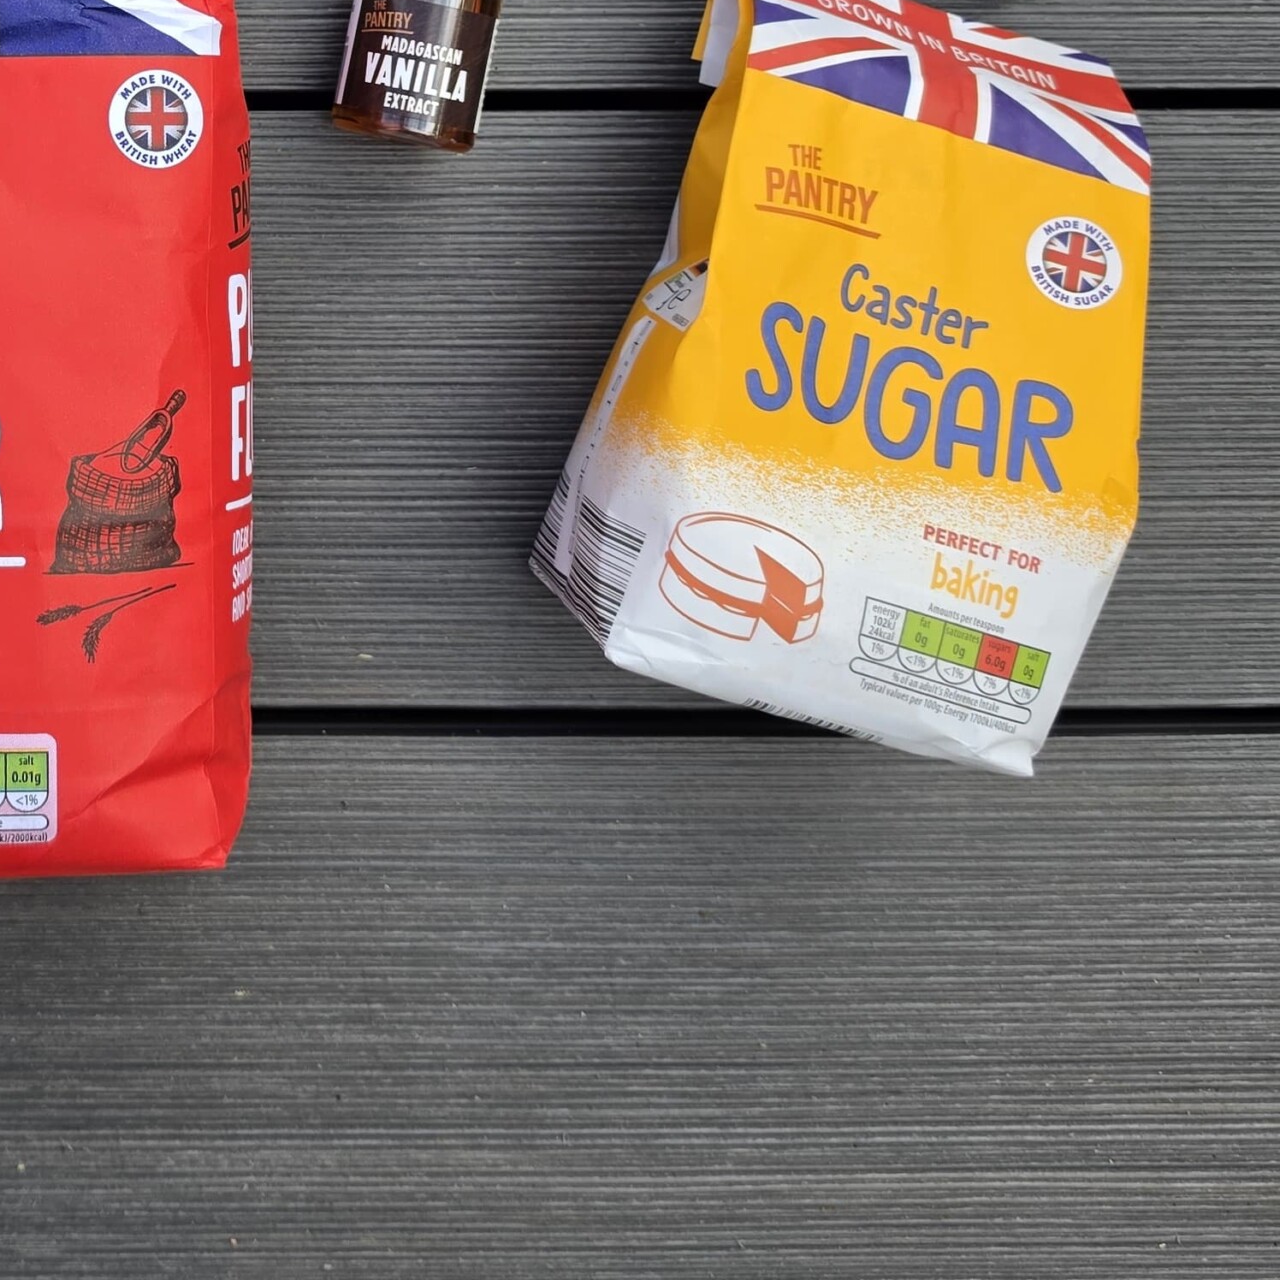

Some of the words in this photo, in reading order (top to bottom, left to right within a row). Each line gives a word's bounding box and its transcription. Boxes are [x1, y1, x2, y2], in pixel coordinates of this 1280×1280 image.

[374, 0, 387, 10] THE
[365, 12, 413, 29] PANTRY
[381, 35, 463, 66] MADAGASCAN
[918, 31, 946, 54] IN
[950, 45, 1058, 91] BRITAIN
[365, 51, 468, 103] VANILLA
[120, 75, 155, 100] MADE
[161, 75, 192, 100] WITH
[383, 92, 439, 117] EXTRACT
[115, 131, 158, 166] BRITISH
[162, 130, 197, 165] WHEAT
[788, 143, 823, 171] THE
[765, 166, 879, 225] PANTRY
[1043, 220, 1079, 236] MADE
[1085, 224, 1114, 252] WITH
[1031, 265, 1069, 303] BRITISH
[1075, 284, 1114, 305] SUGAR
[841, 263, 989, 349] Caster
[745, 301, 1073, 493] SUGAR
[923, 524, 1003, 562] PERFECT
[1007, 549, 1041, 574] FOR
[931, 551, 1019, 619] baking
[872, 604, 901, 620] energy
[928, 602, 960, 621] Amounts
[960, 614, 973, 625] per
[973, 617, 1005, 634] teaspoon
[873, 616, 896, 630] 102kJ
[920, 616, 931, 629] fat
[868, 626, 896, 641] 24kcal
[915, 633, 928, 648] 0g
[946, 627, 980, 644] saturates
[871, 643, 885, 655] 1%
[952, 644, 966, 659] 0g
[988, 640, 1011, 654] sugars
[906, 654, 927, 669] <1%
[985, 655, 1007, 671] 6.0g
[1027, 651, 1040, 663] salt
[943, 665, 964, 680] <1%
[1023, 665, 1035, 681] 0g
[983, 676, 997, 690] 7%
[860, 678, 886, 694] Typical
[886, 689, 909, 701] values
[909, 696, 923, 705] per
[943, 704, 969, 722] Energy
[908, 679, 918, 688] an
[943, 688, 979, 706] Reference
[979, 699, 1000, 713] Intake
[1015, 685, 1032, 699] <1%
[19, 755, 34, 766] salt
[11, 771, 42, 786] 0.01g
[15, 794, 38, 806] <1%
